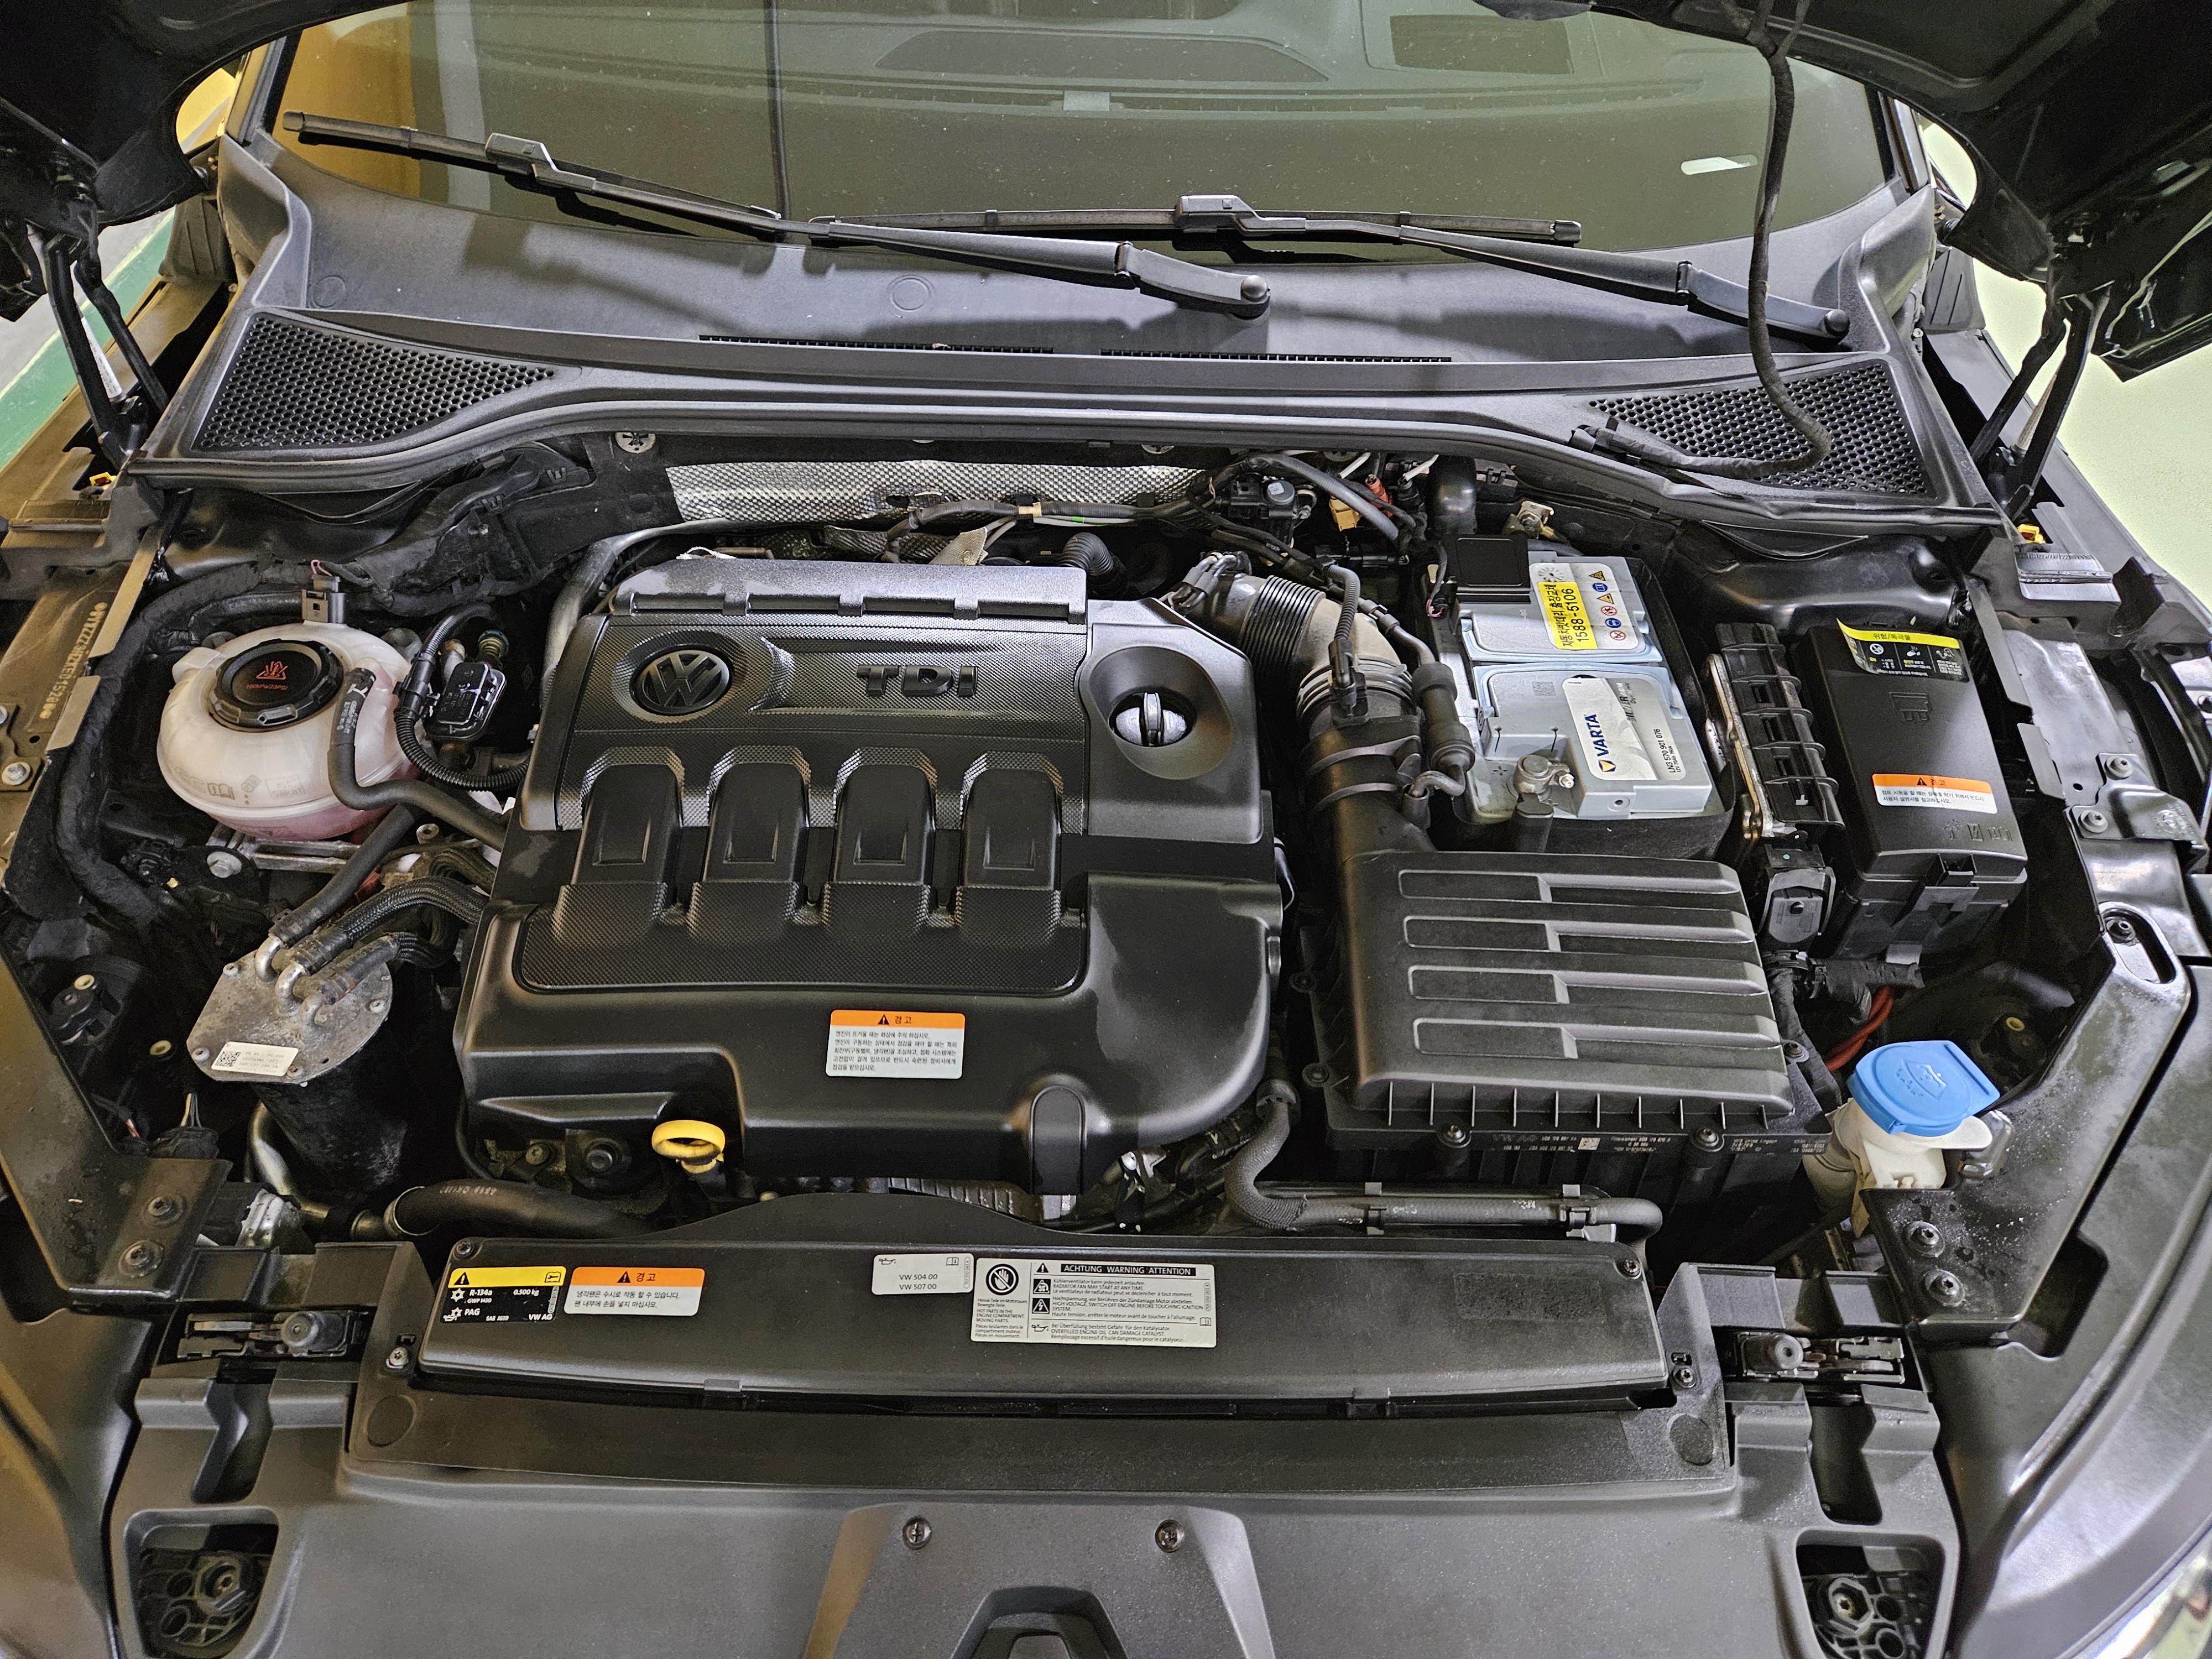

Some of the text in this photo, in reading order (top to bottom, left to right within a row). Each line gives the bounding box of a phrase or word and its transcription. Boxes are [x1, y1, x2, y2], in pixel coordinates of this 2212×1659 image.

[1562, 588, 1589, 642] 1588-5106
[856, 664, 978, 697] TDI
[1584, 713, 1609, 757] VARTA
[1653, 728, 1676, 773] LN3 570 901 076
[637, 1273, 656, 1282] 경고
[1148, 1267, 1191, 1275] ATTENTION
